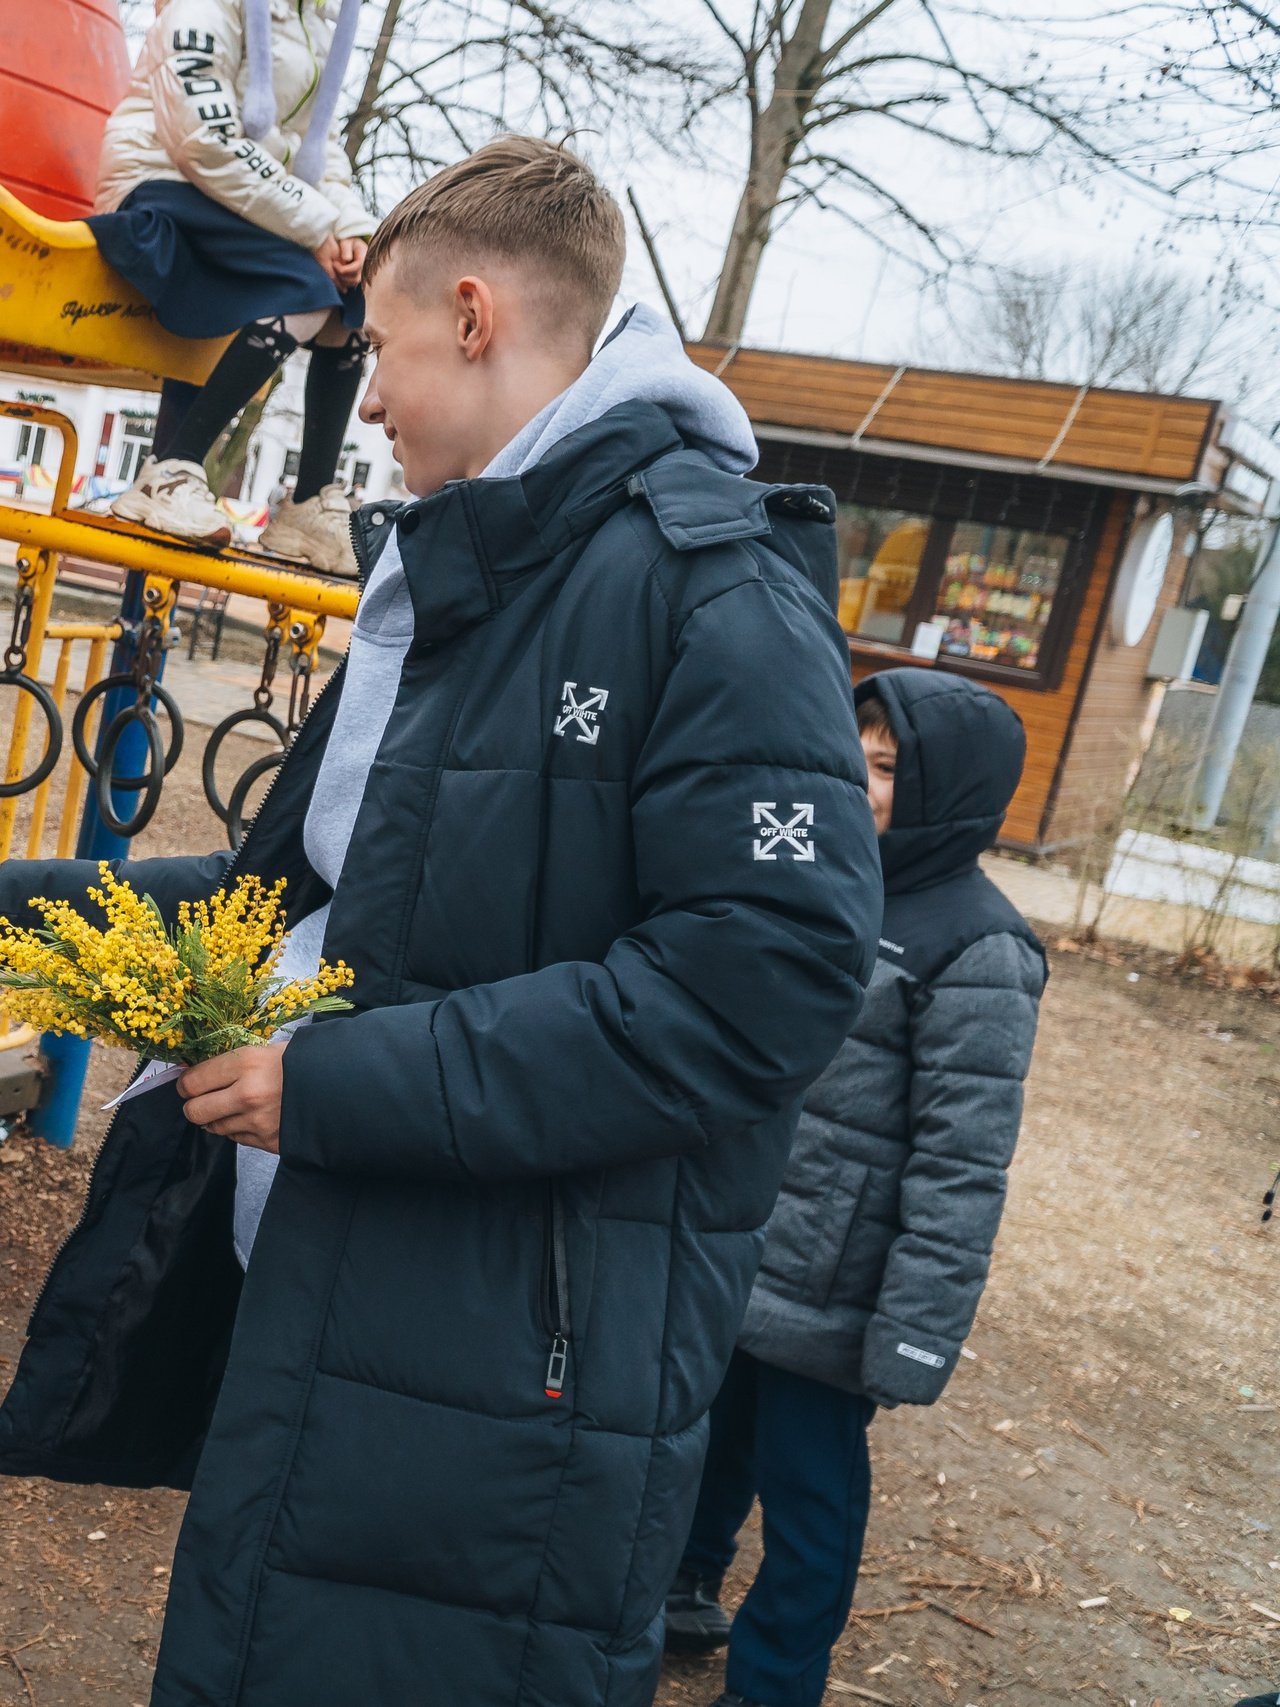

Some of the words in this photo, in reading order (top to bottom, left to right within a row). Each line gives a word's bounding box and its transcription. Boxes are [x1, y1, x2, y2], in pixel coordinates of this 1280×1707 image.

[173, 28, 222, 96] ONE
[234, 141, 278, 179] ARE
[760, 827, 778, 837] OFF
[779, 828, 809, 838] WIHTE
